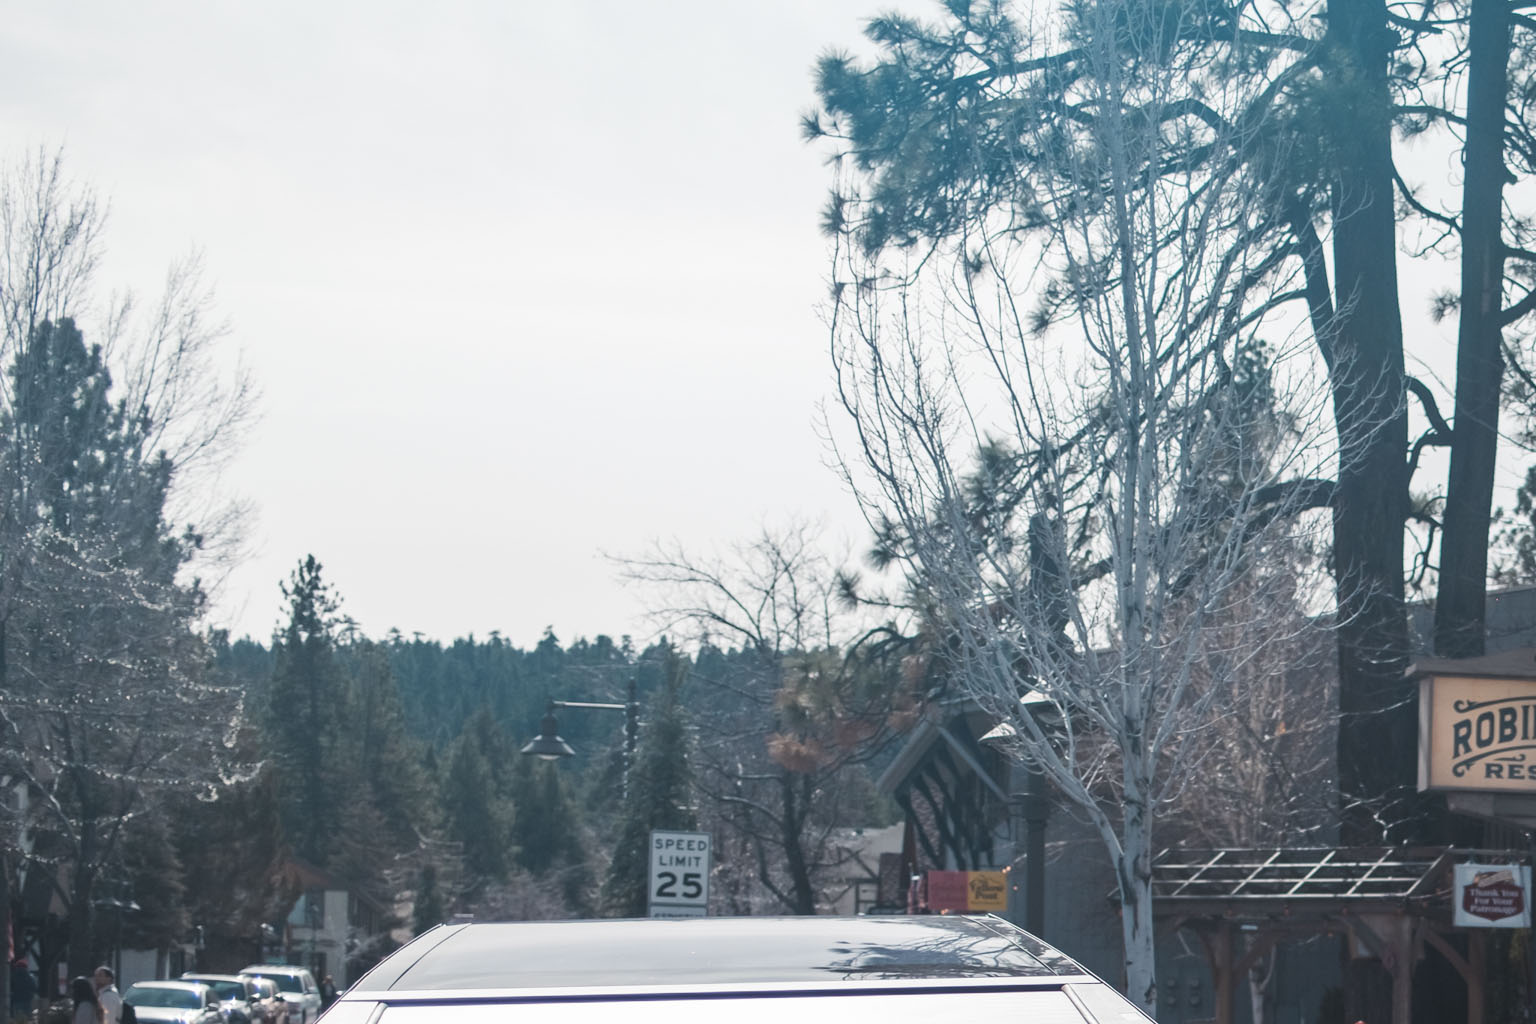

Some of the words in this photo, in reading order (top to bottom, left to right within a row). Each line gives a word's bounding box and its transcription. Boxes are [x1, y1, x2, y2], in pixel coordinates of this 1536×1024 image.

[655, 838, 707, 851] SPEED
[659, 855, 701, 867] LIMIT
[656, 871, 703, 899] 25
[1470, 888, 1498, 896] Thank
